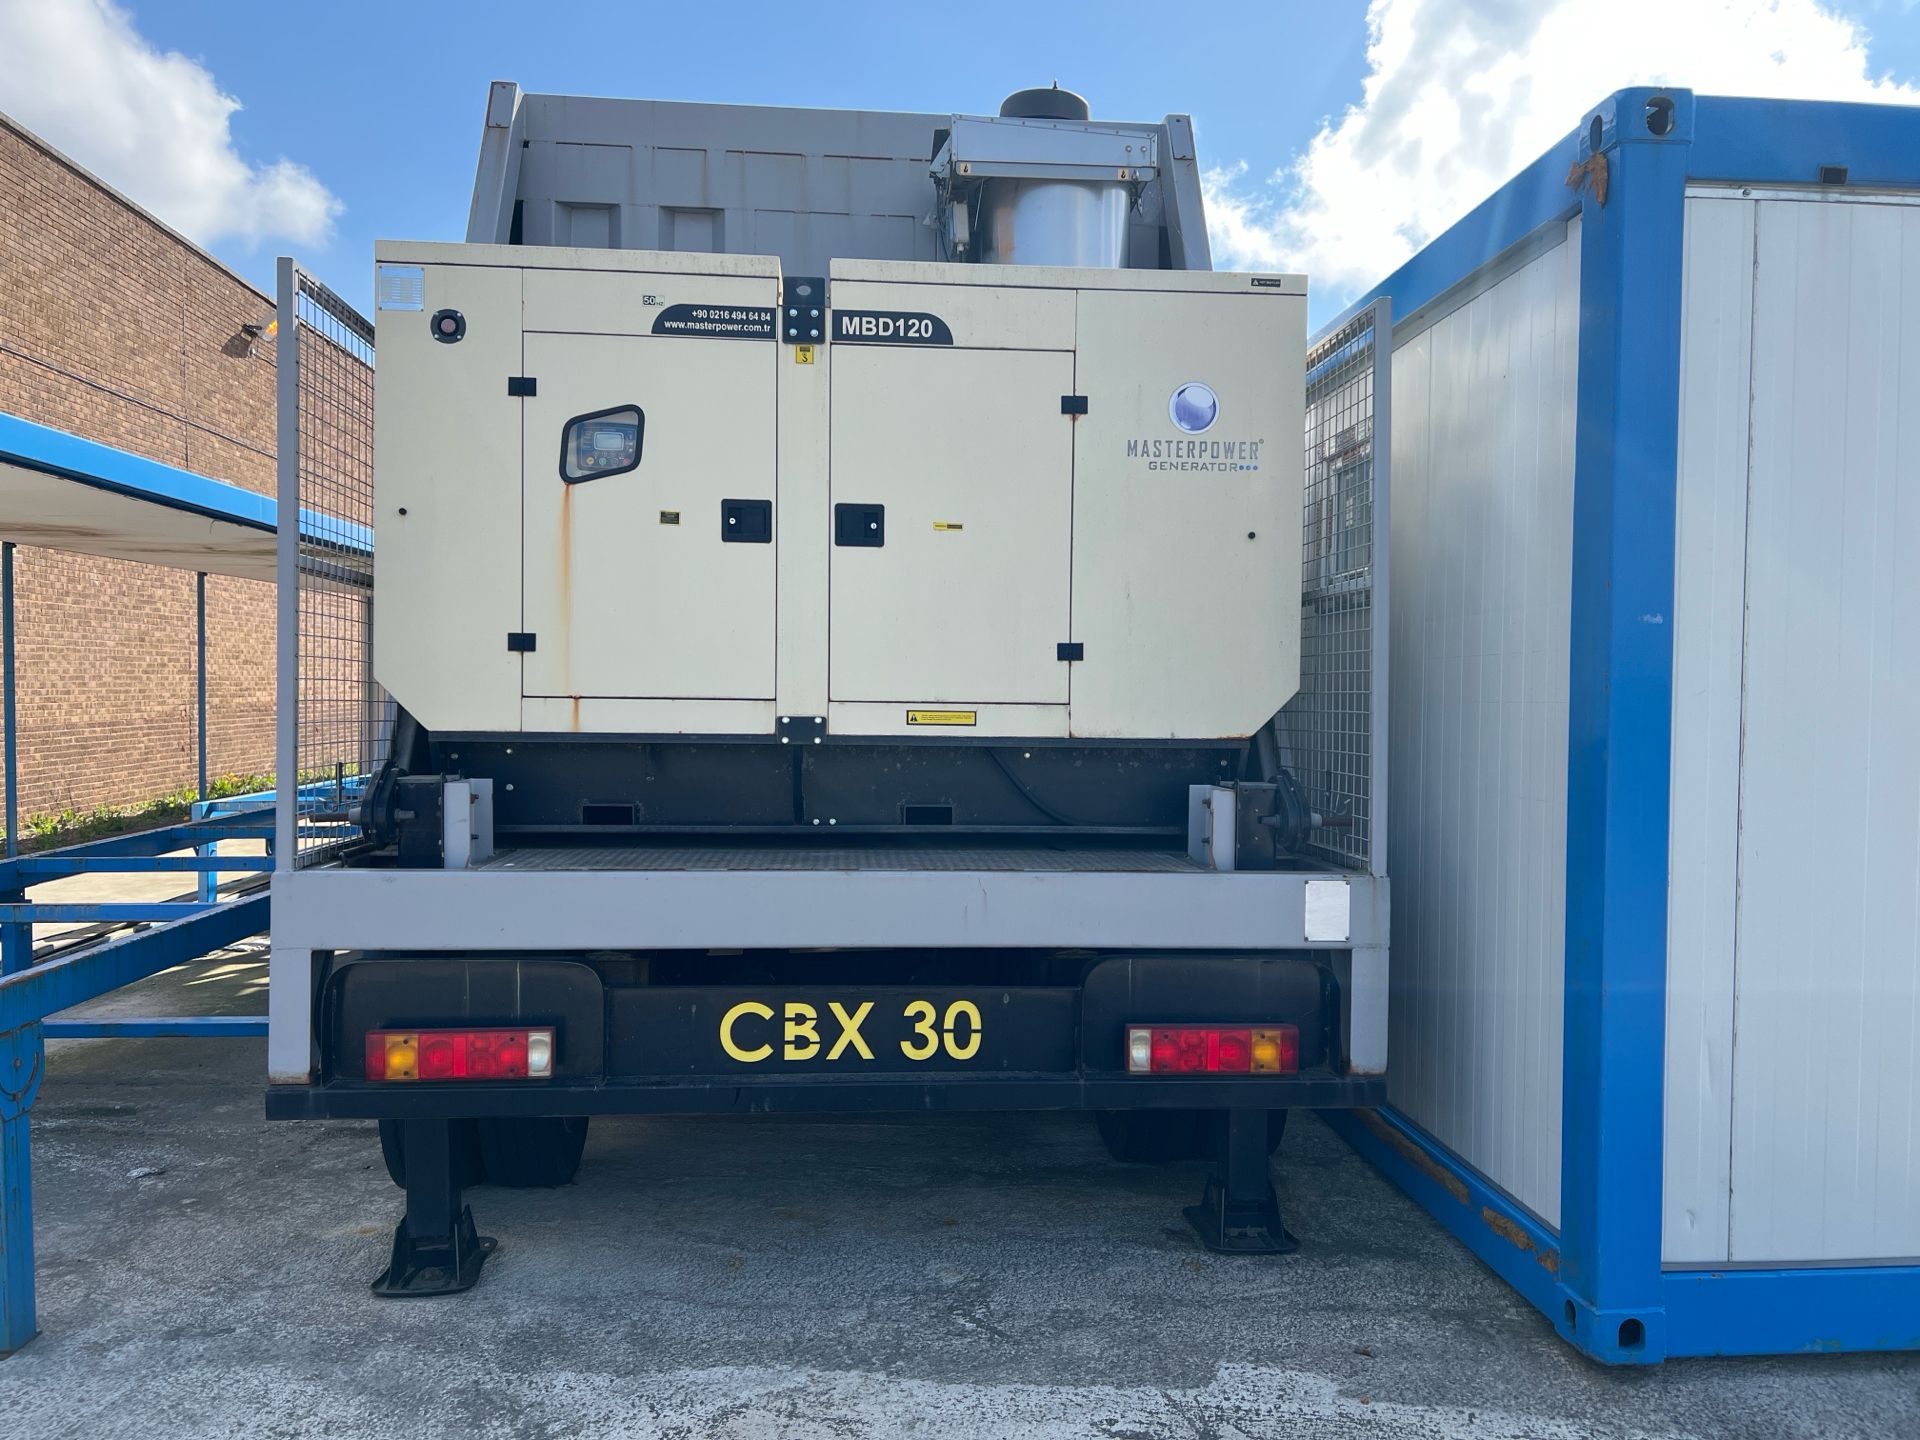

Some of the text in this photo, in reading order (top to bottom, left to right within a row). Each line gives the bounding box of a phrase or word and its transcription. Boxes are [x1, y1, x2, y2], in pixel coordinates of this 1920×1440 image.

[644, 296, 655, 305] 50
[692, 310, 771, 321] +90 0216 494 64 84
[664, 320, 771, 332] www.masterpower.com.tr
[842, 316, 933, 338] MBD120
[1148, 461, 1238, 472] GENERATOR
[719, 1000, 982, 1063] CBX 30
